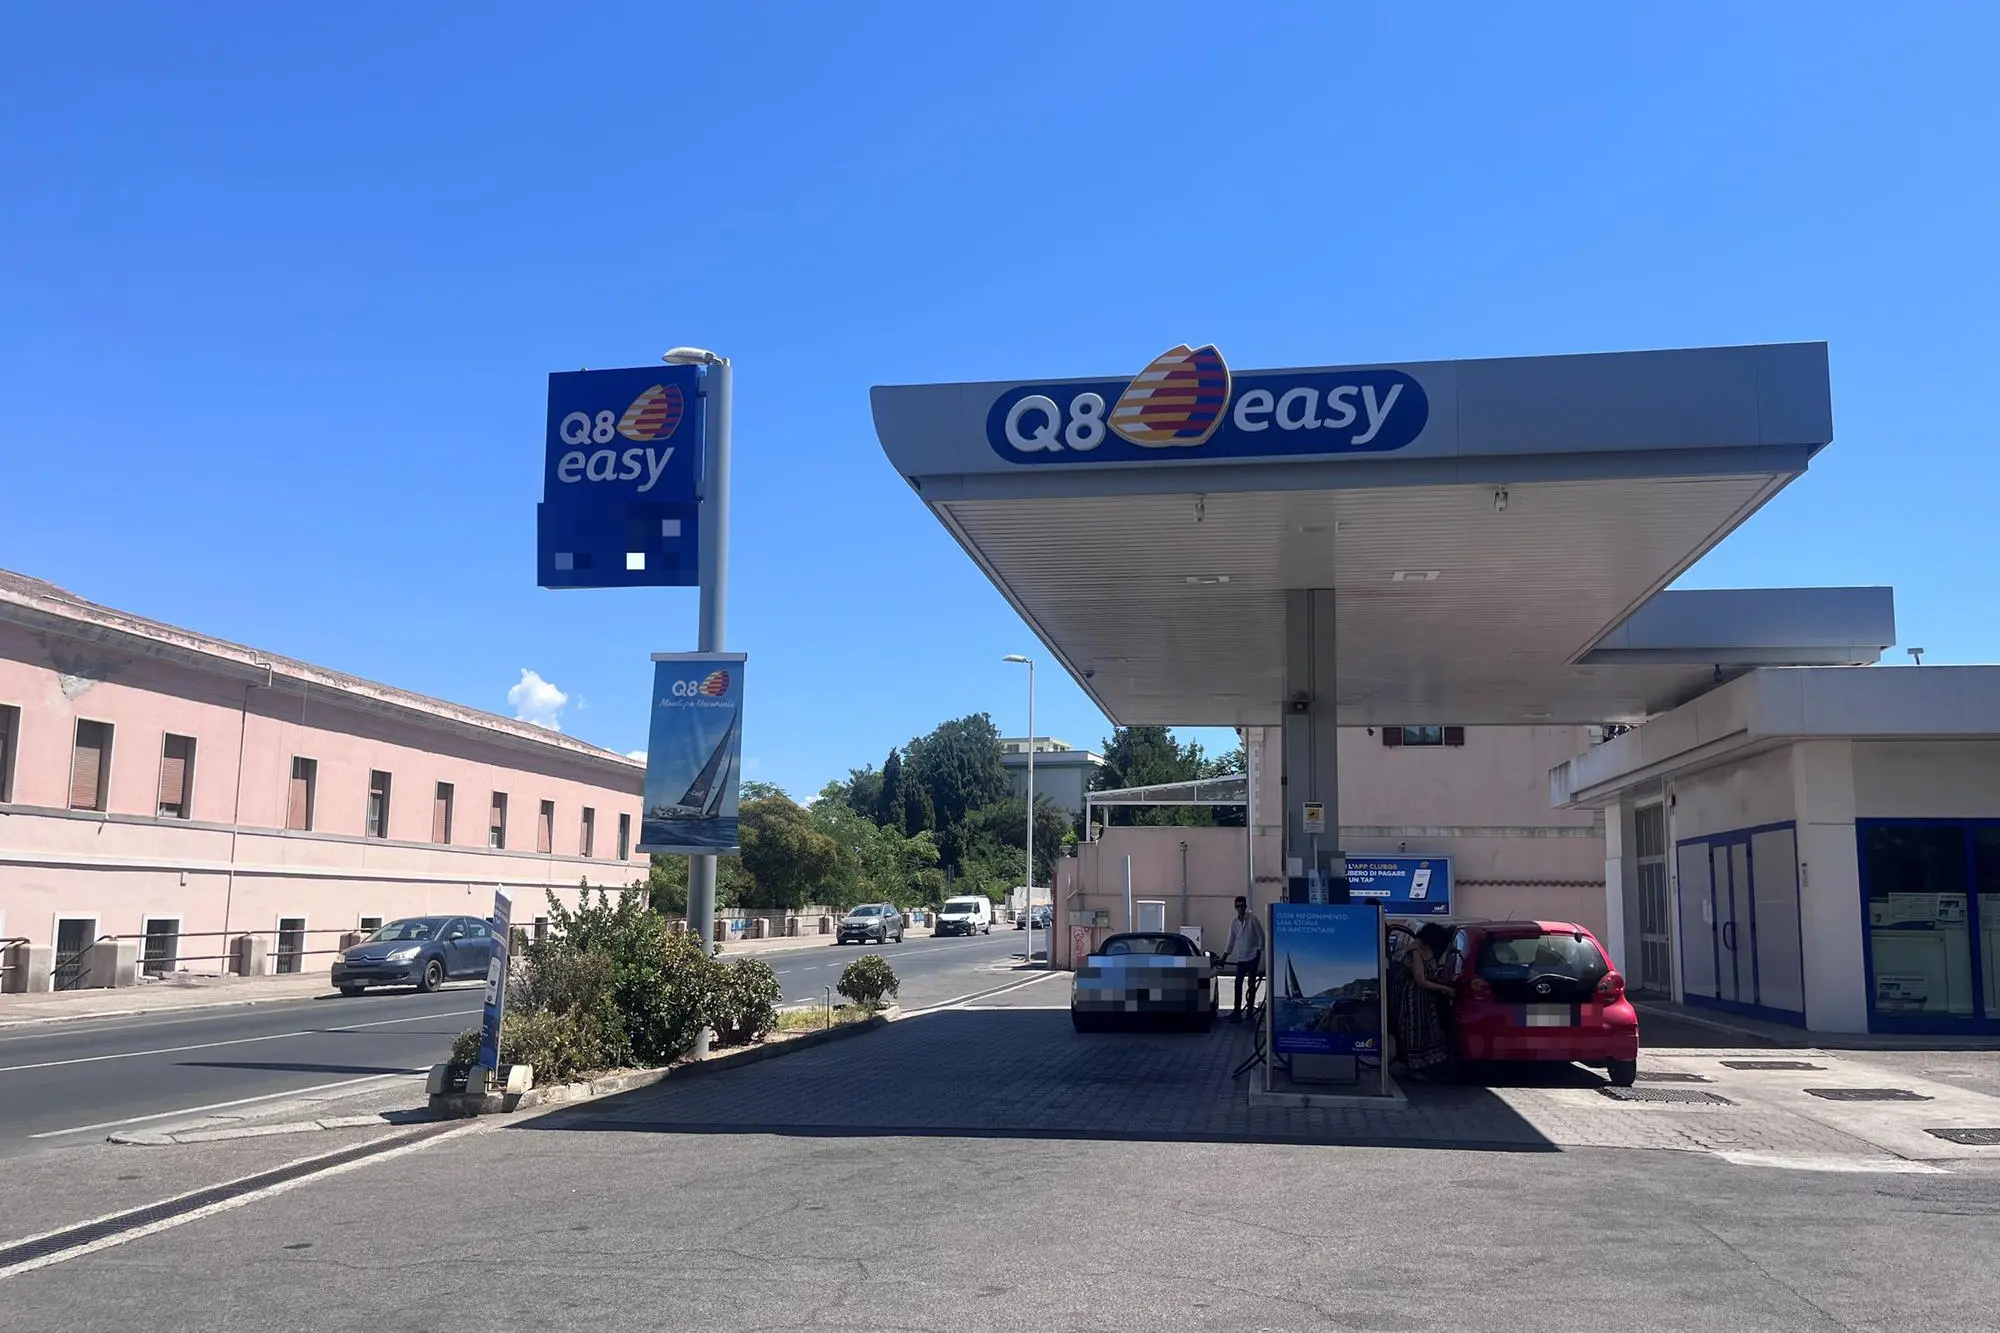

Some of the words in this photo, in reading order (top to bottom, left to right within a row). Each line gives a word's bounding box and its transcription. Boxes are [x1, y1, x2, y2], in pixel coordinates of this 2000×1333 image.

[559, 410, 616, 446] Q8
[1004, 391, 1106, 454] Q8
[1232, 380, 1404, 446] easy
[556, 446, 675, 493] easy
[671, 680, 698, 697] Q8
